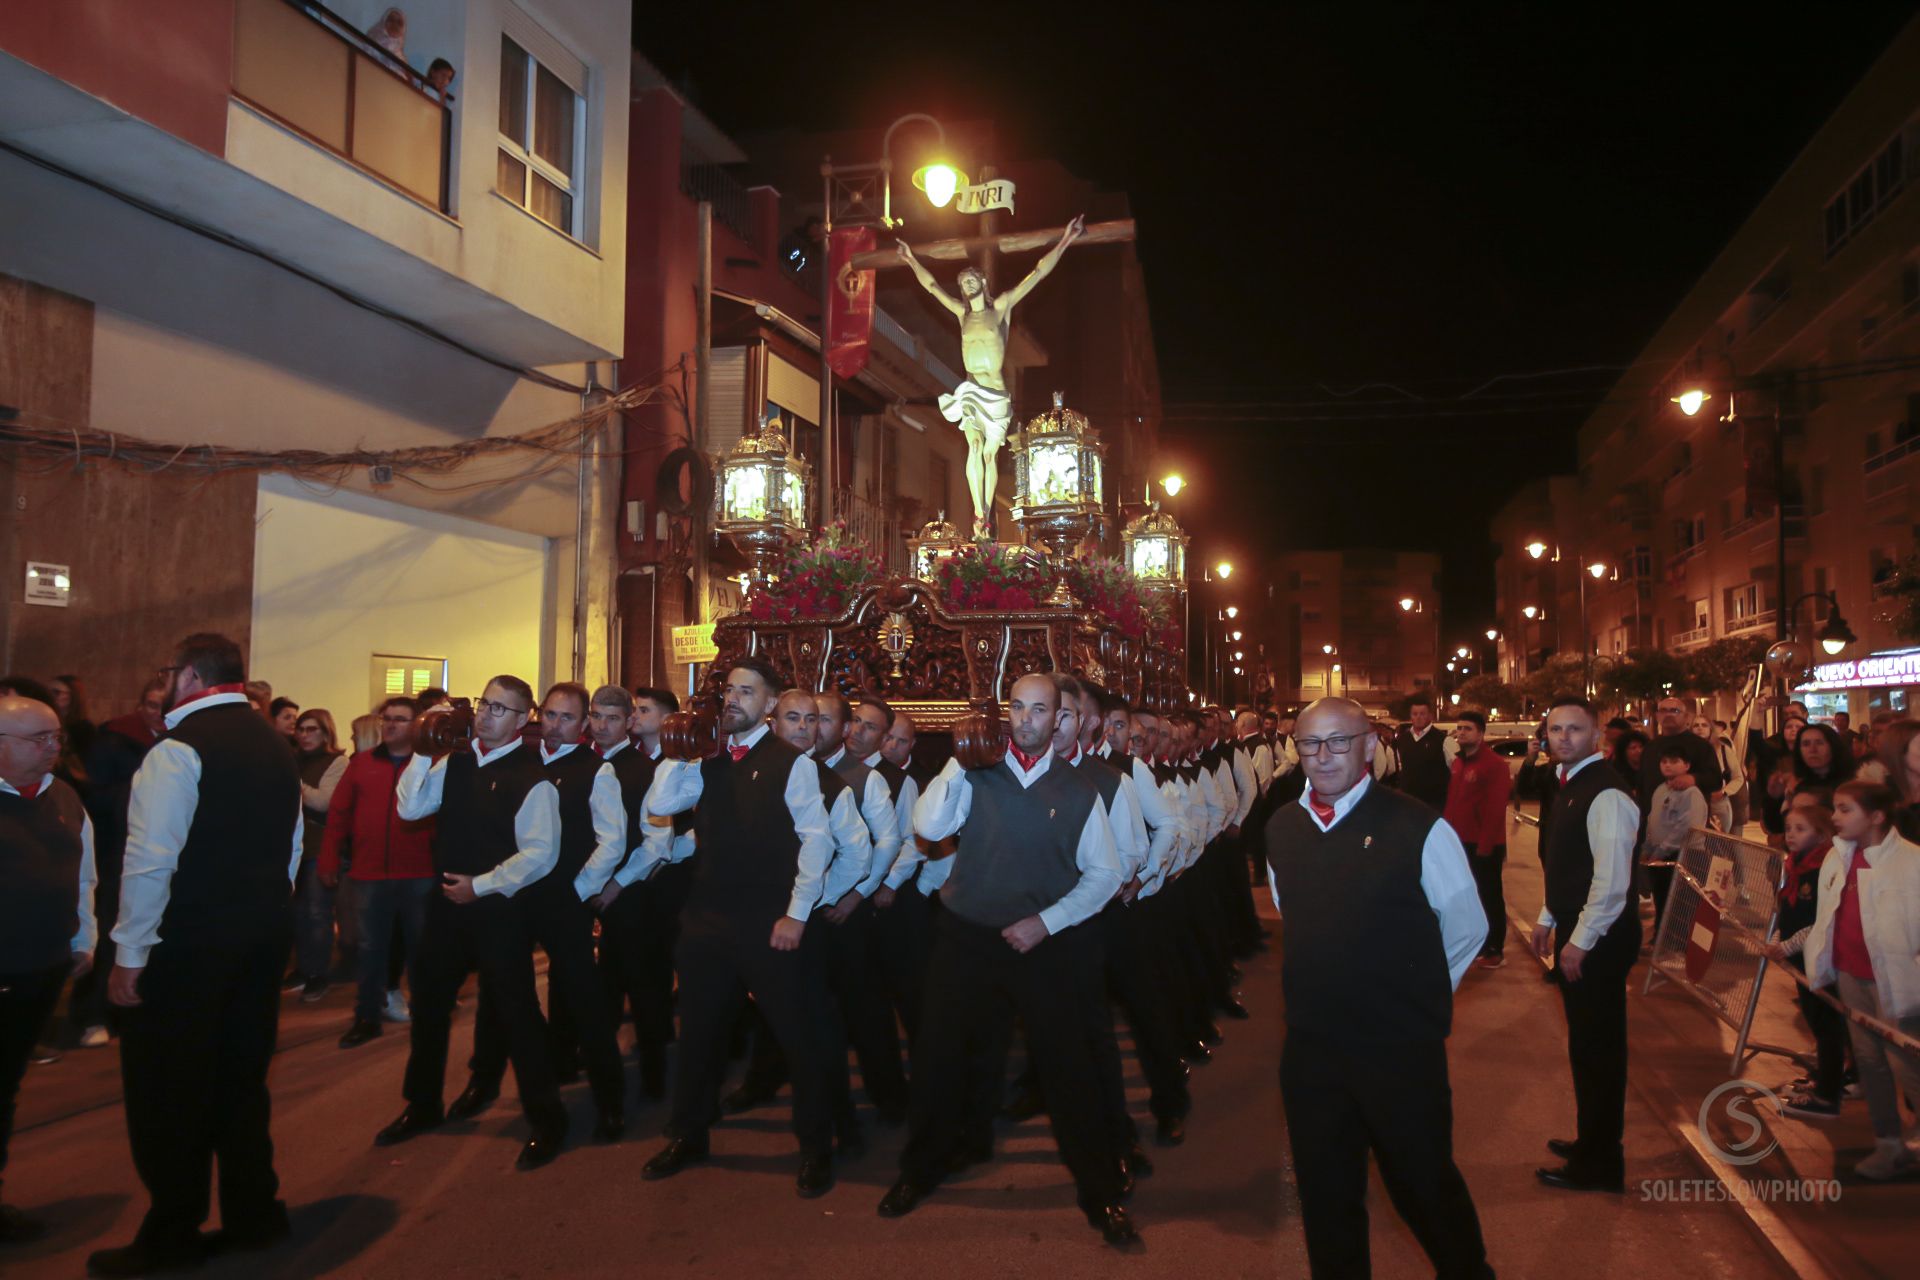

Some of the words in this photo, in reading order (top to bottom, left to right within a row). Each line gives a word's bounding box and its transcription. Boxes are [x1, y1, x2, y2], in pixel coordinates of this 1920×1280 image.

[969, 186, 1003, 208] INRI
[17, 495, 26, 510] 9
[675, 636, 698, 647] DESDE
